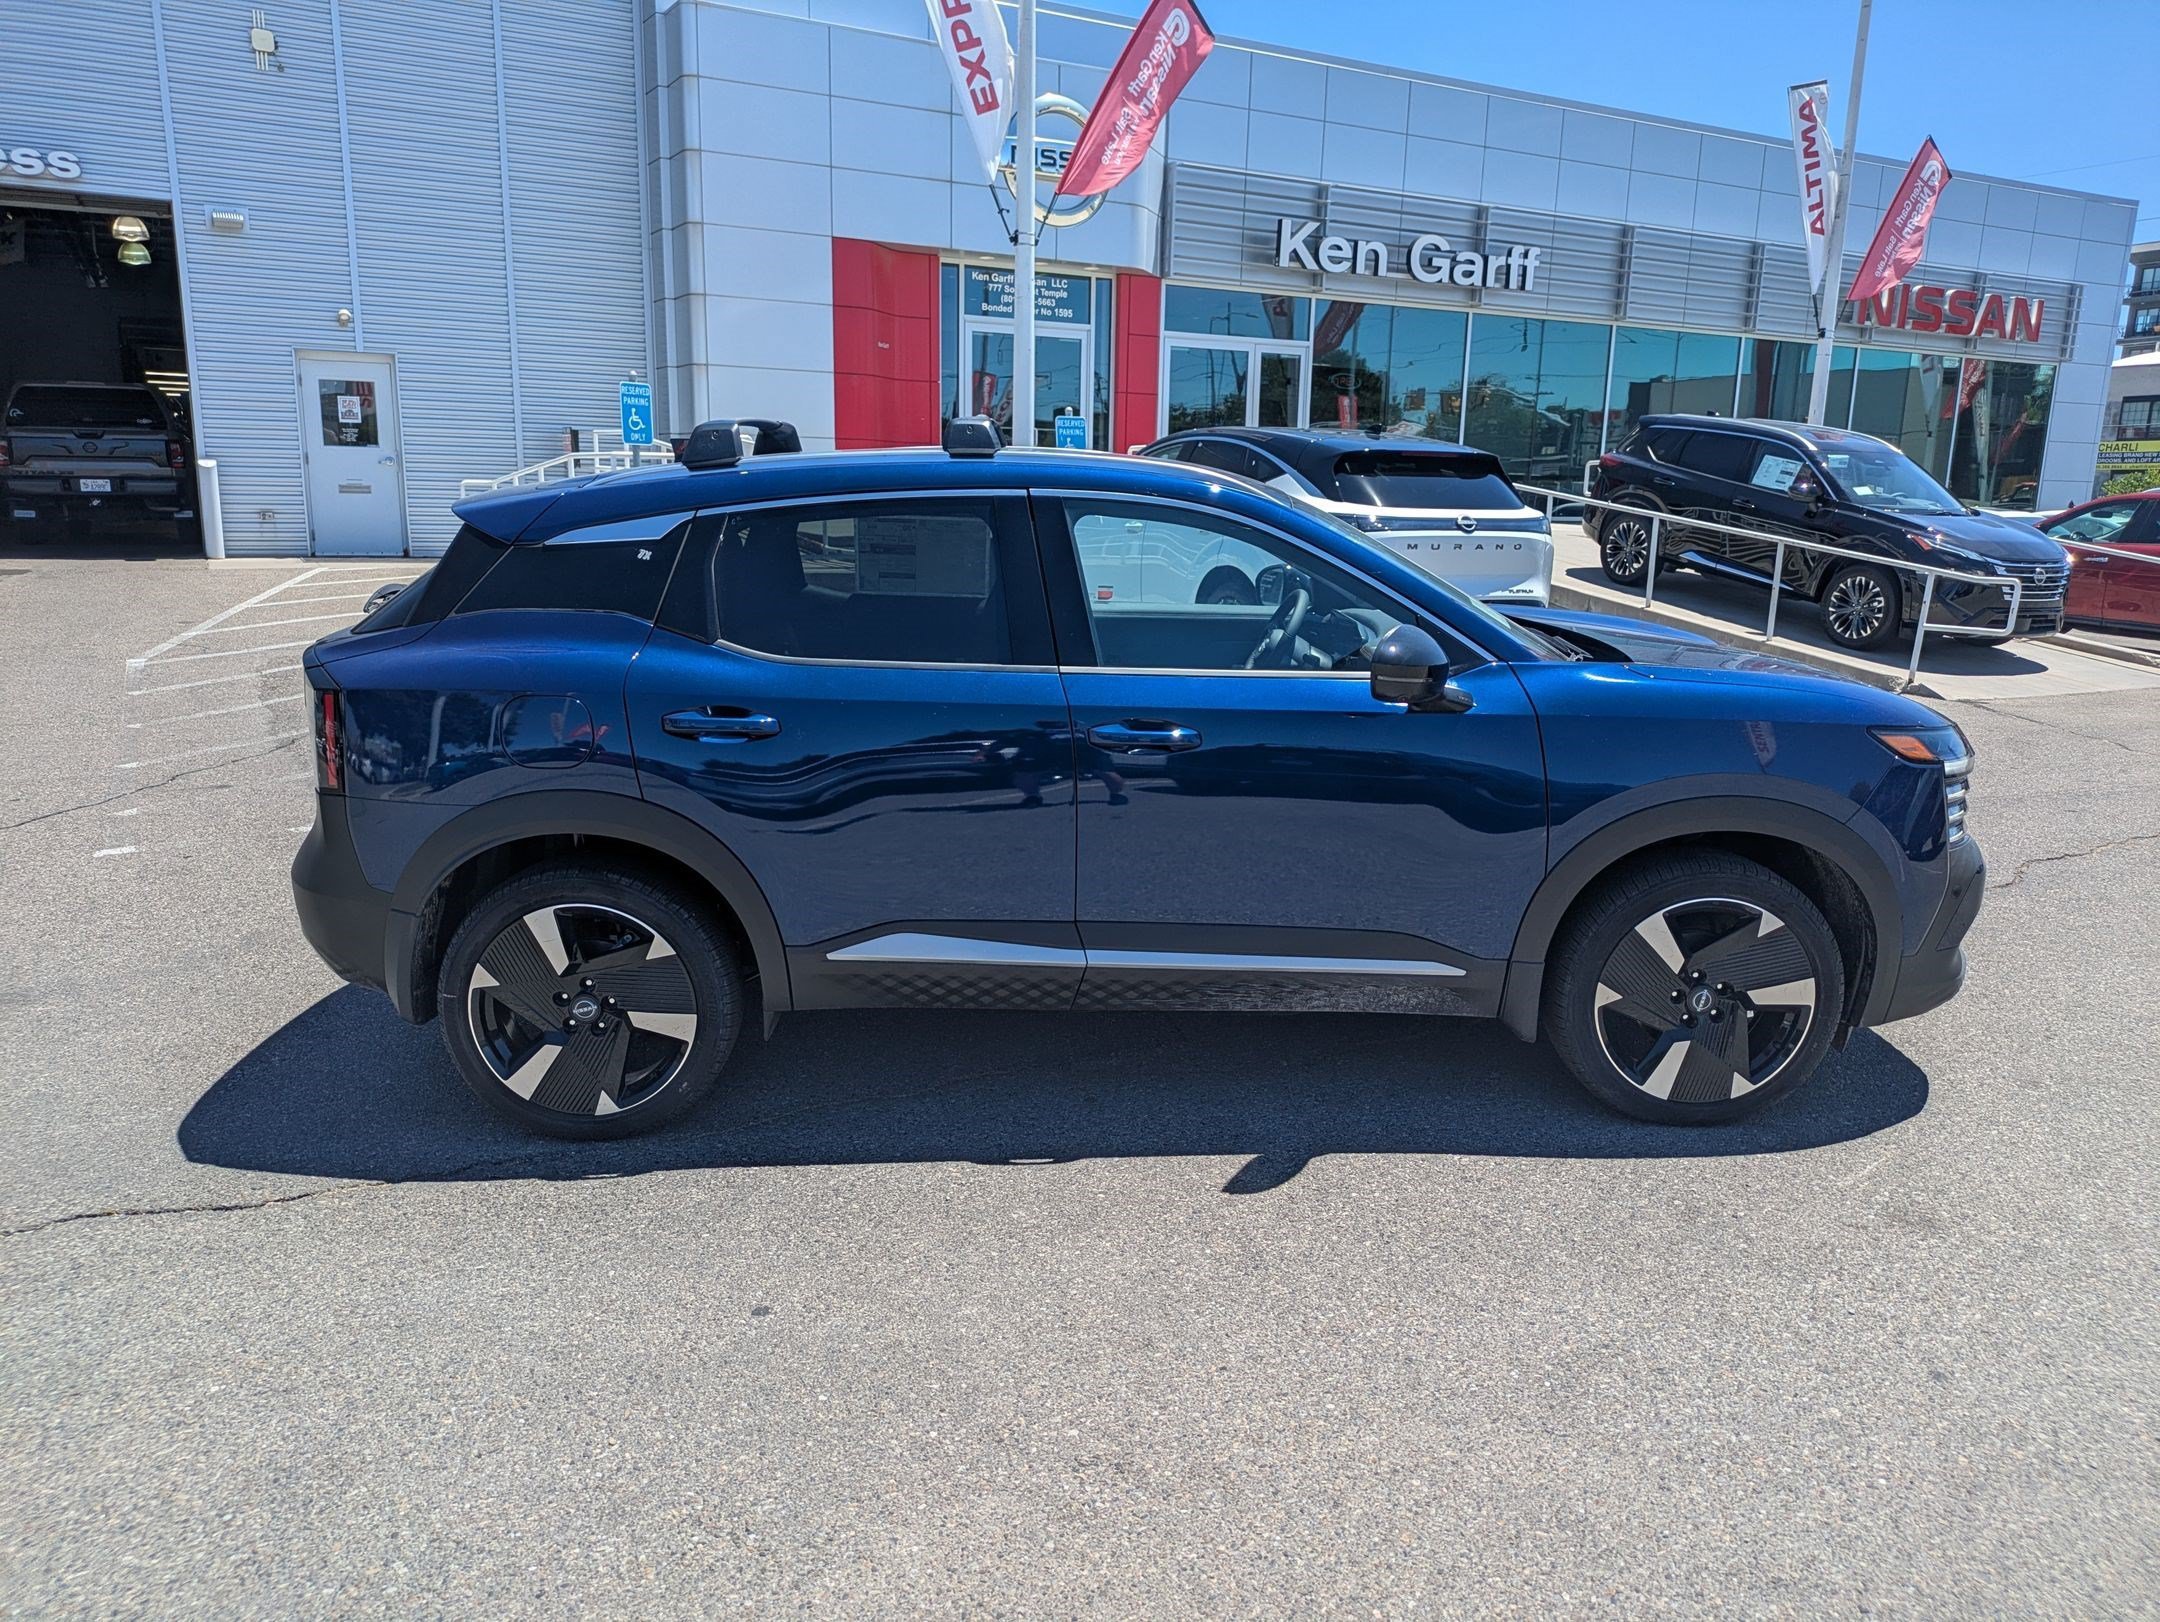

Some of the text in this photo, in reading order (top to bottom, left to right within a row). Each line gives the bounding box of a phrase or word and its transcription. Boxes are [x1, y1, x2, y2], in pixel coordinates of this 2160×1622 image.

[0, 147, 81, 178] ss
[1798, 96, 1825, 236] ALTIMA
[1275, 218, 1541, 291] Ken Garff
[972, 271, 990, 282] Ken
[991, 273, 1014, 284] Garff
[1051, 278, 1068, 288] LLC
[988, 283, 1002, 292] 777
[1040, 288, 1068, 299] Temple
[981, 303, 1013, 313] Bonded
[1040, 308, 1052, 316] No
[1054, 308, 1073, 318] 1595
[1856, 284, 2045, 343] NISSAN
[621, 386, 650, 396] RESERVED
[623, 396, 649, 407] PARKING
[1057, 419, 1085, 427] RESERVED
[630, 432, 646, 442] ONLY
[1059, 428, 1084, 436] PARKING
[2098, 443, 2139, 452] CHARLI
[1406, 543, 1523, 551] MURANO
